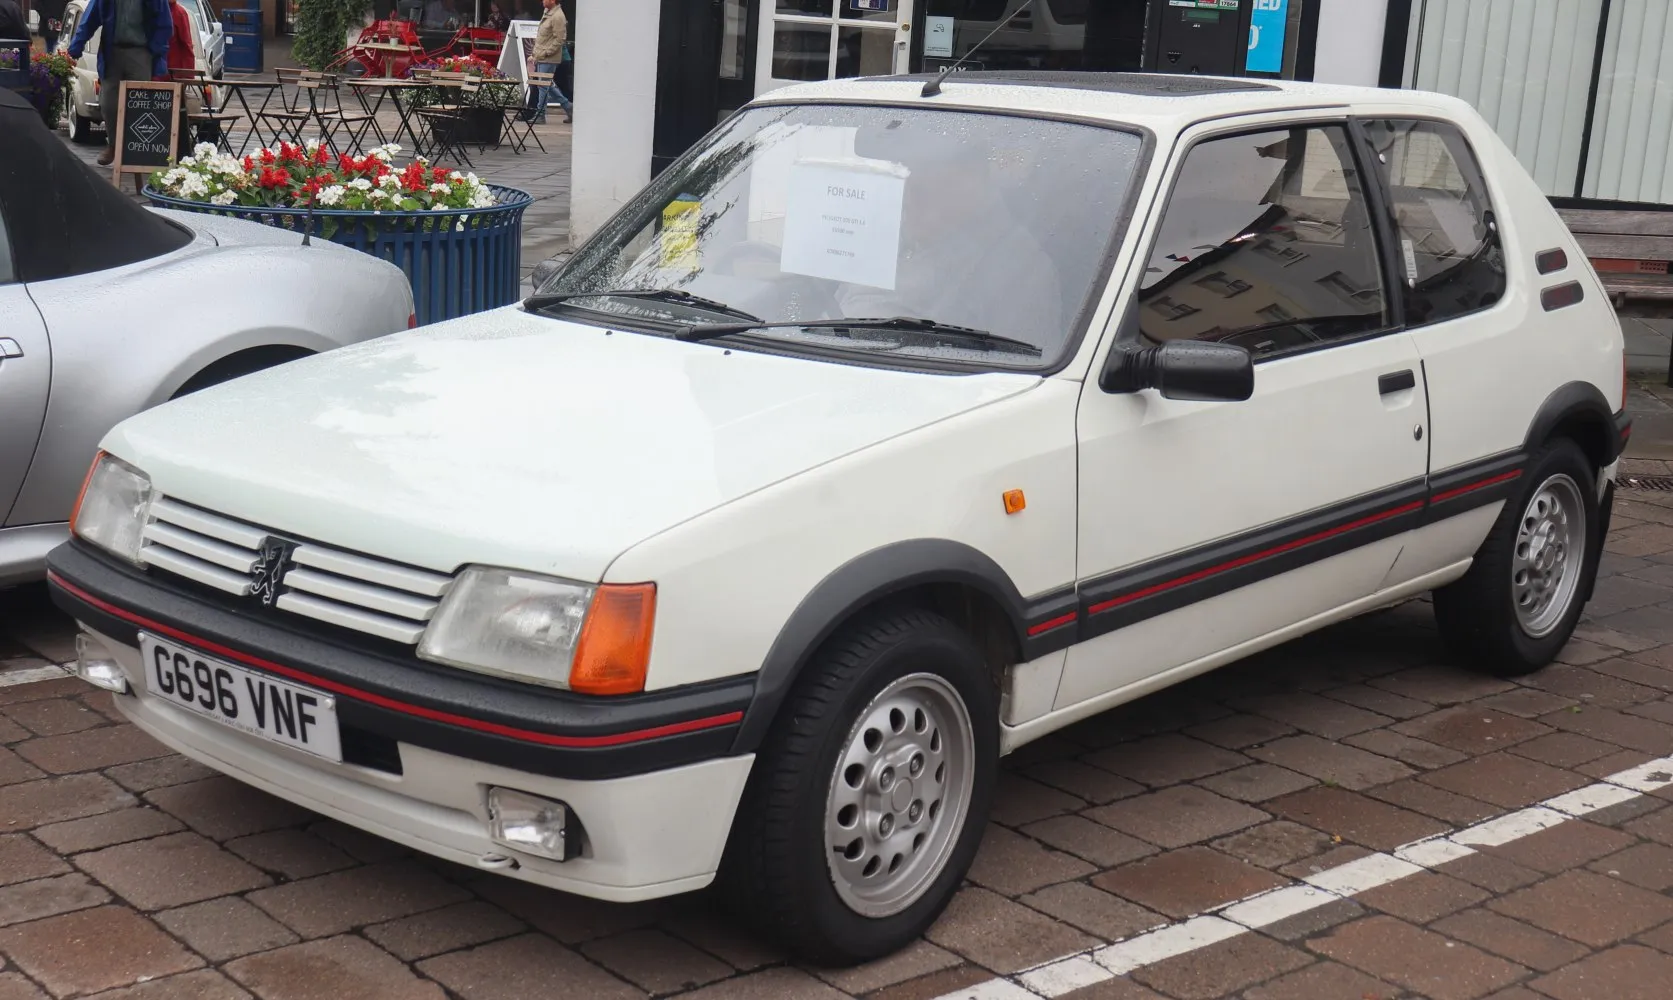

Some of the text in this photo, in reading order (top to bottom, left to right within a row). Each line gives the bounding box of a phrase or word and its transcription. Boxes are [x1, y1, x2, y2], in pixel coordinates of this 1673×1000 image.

[129, 90, 171, 100] CAKE AND
[127, 100, 172, 110] COFFEE SHOP
[127, 141, 170, 153] OPEN NOW
[827, 185, 867, 200] FOR SALE
[153, 644, 318, 744] G696 VNF
